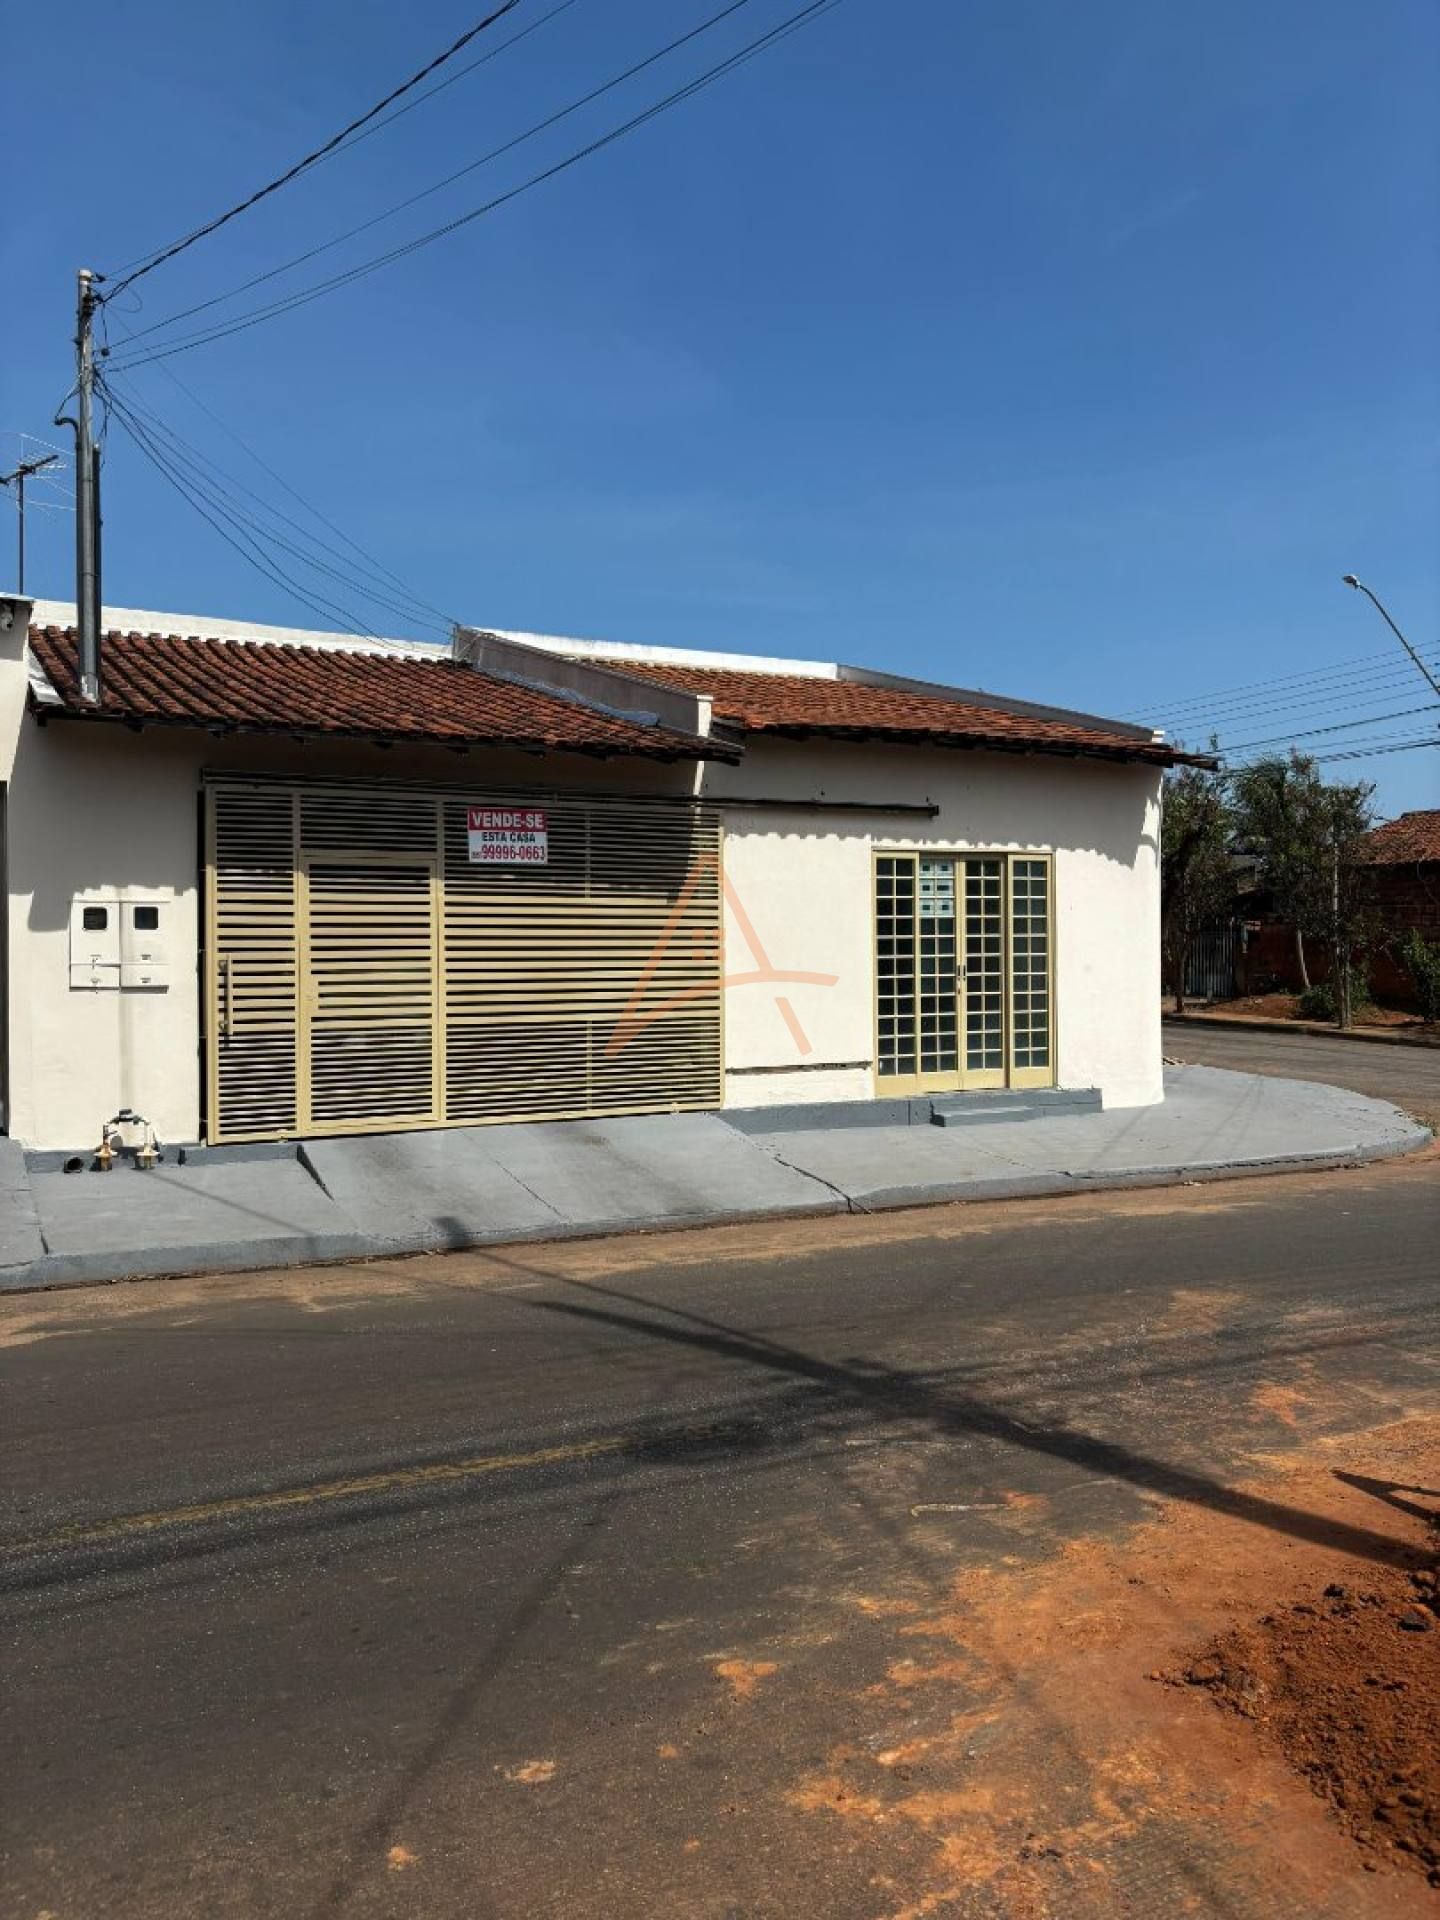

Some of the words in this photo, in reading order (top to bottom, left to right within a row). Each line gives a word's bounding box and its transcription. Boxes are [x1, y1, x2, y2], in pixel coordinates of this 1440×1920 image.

[471, 812, 544, 829] VENDE-SE
[482, 832, 507, 842] ESTA
[510, 832, 536, 843] CASA
